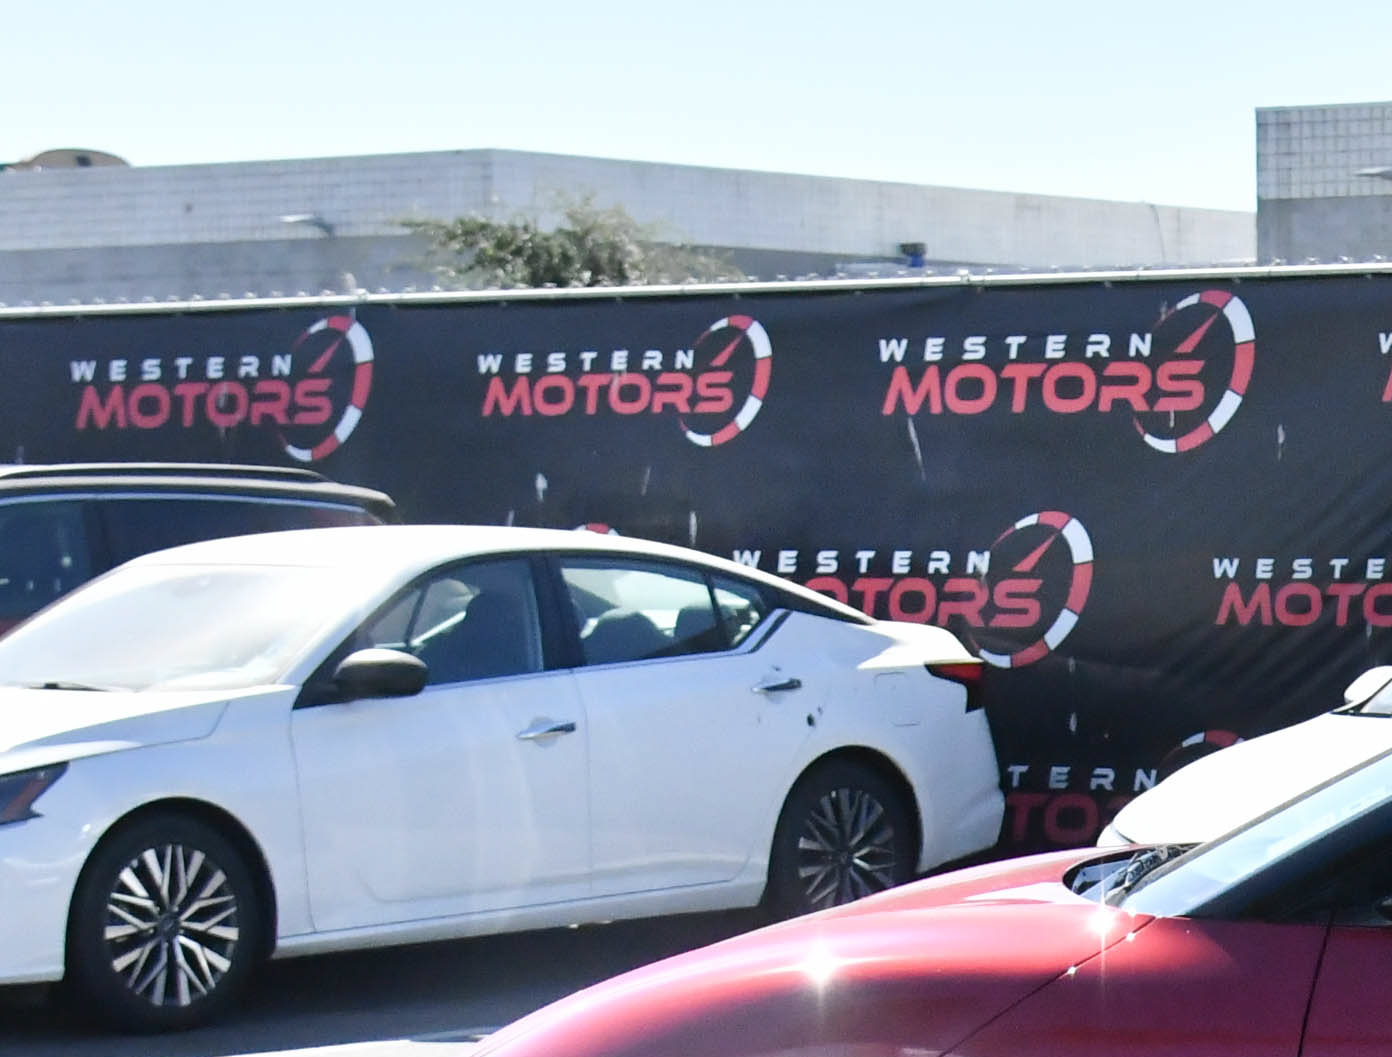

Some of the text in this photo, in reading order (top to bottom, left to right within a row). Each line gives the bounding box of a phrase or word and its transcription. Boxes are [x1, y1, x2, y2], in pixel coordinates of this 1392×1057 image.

[477, 349, 694, 374] WESTERN
[879, 333, 1152, 362] WESTERN
[71, 354, 292, 382] WESTERN
[482, 371, 733, 415] MOTORS
[882, 359, 1204, 415] MOTORS
[76, 380, 331, 429] MOTORS
[732, 549, 990, 575] WESTERN
[1008, 765, 1158, 792] TERN
